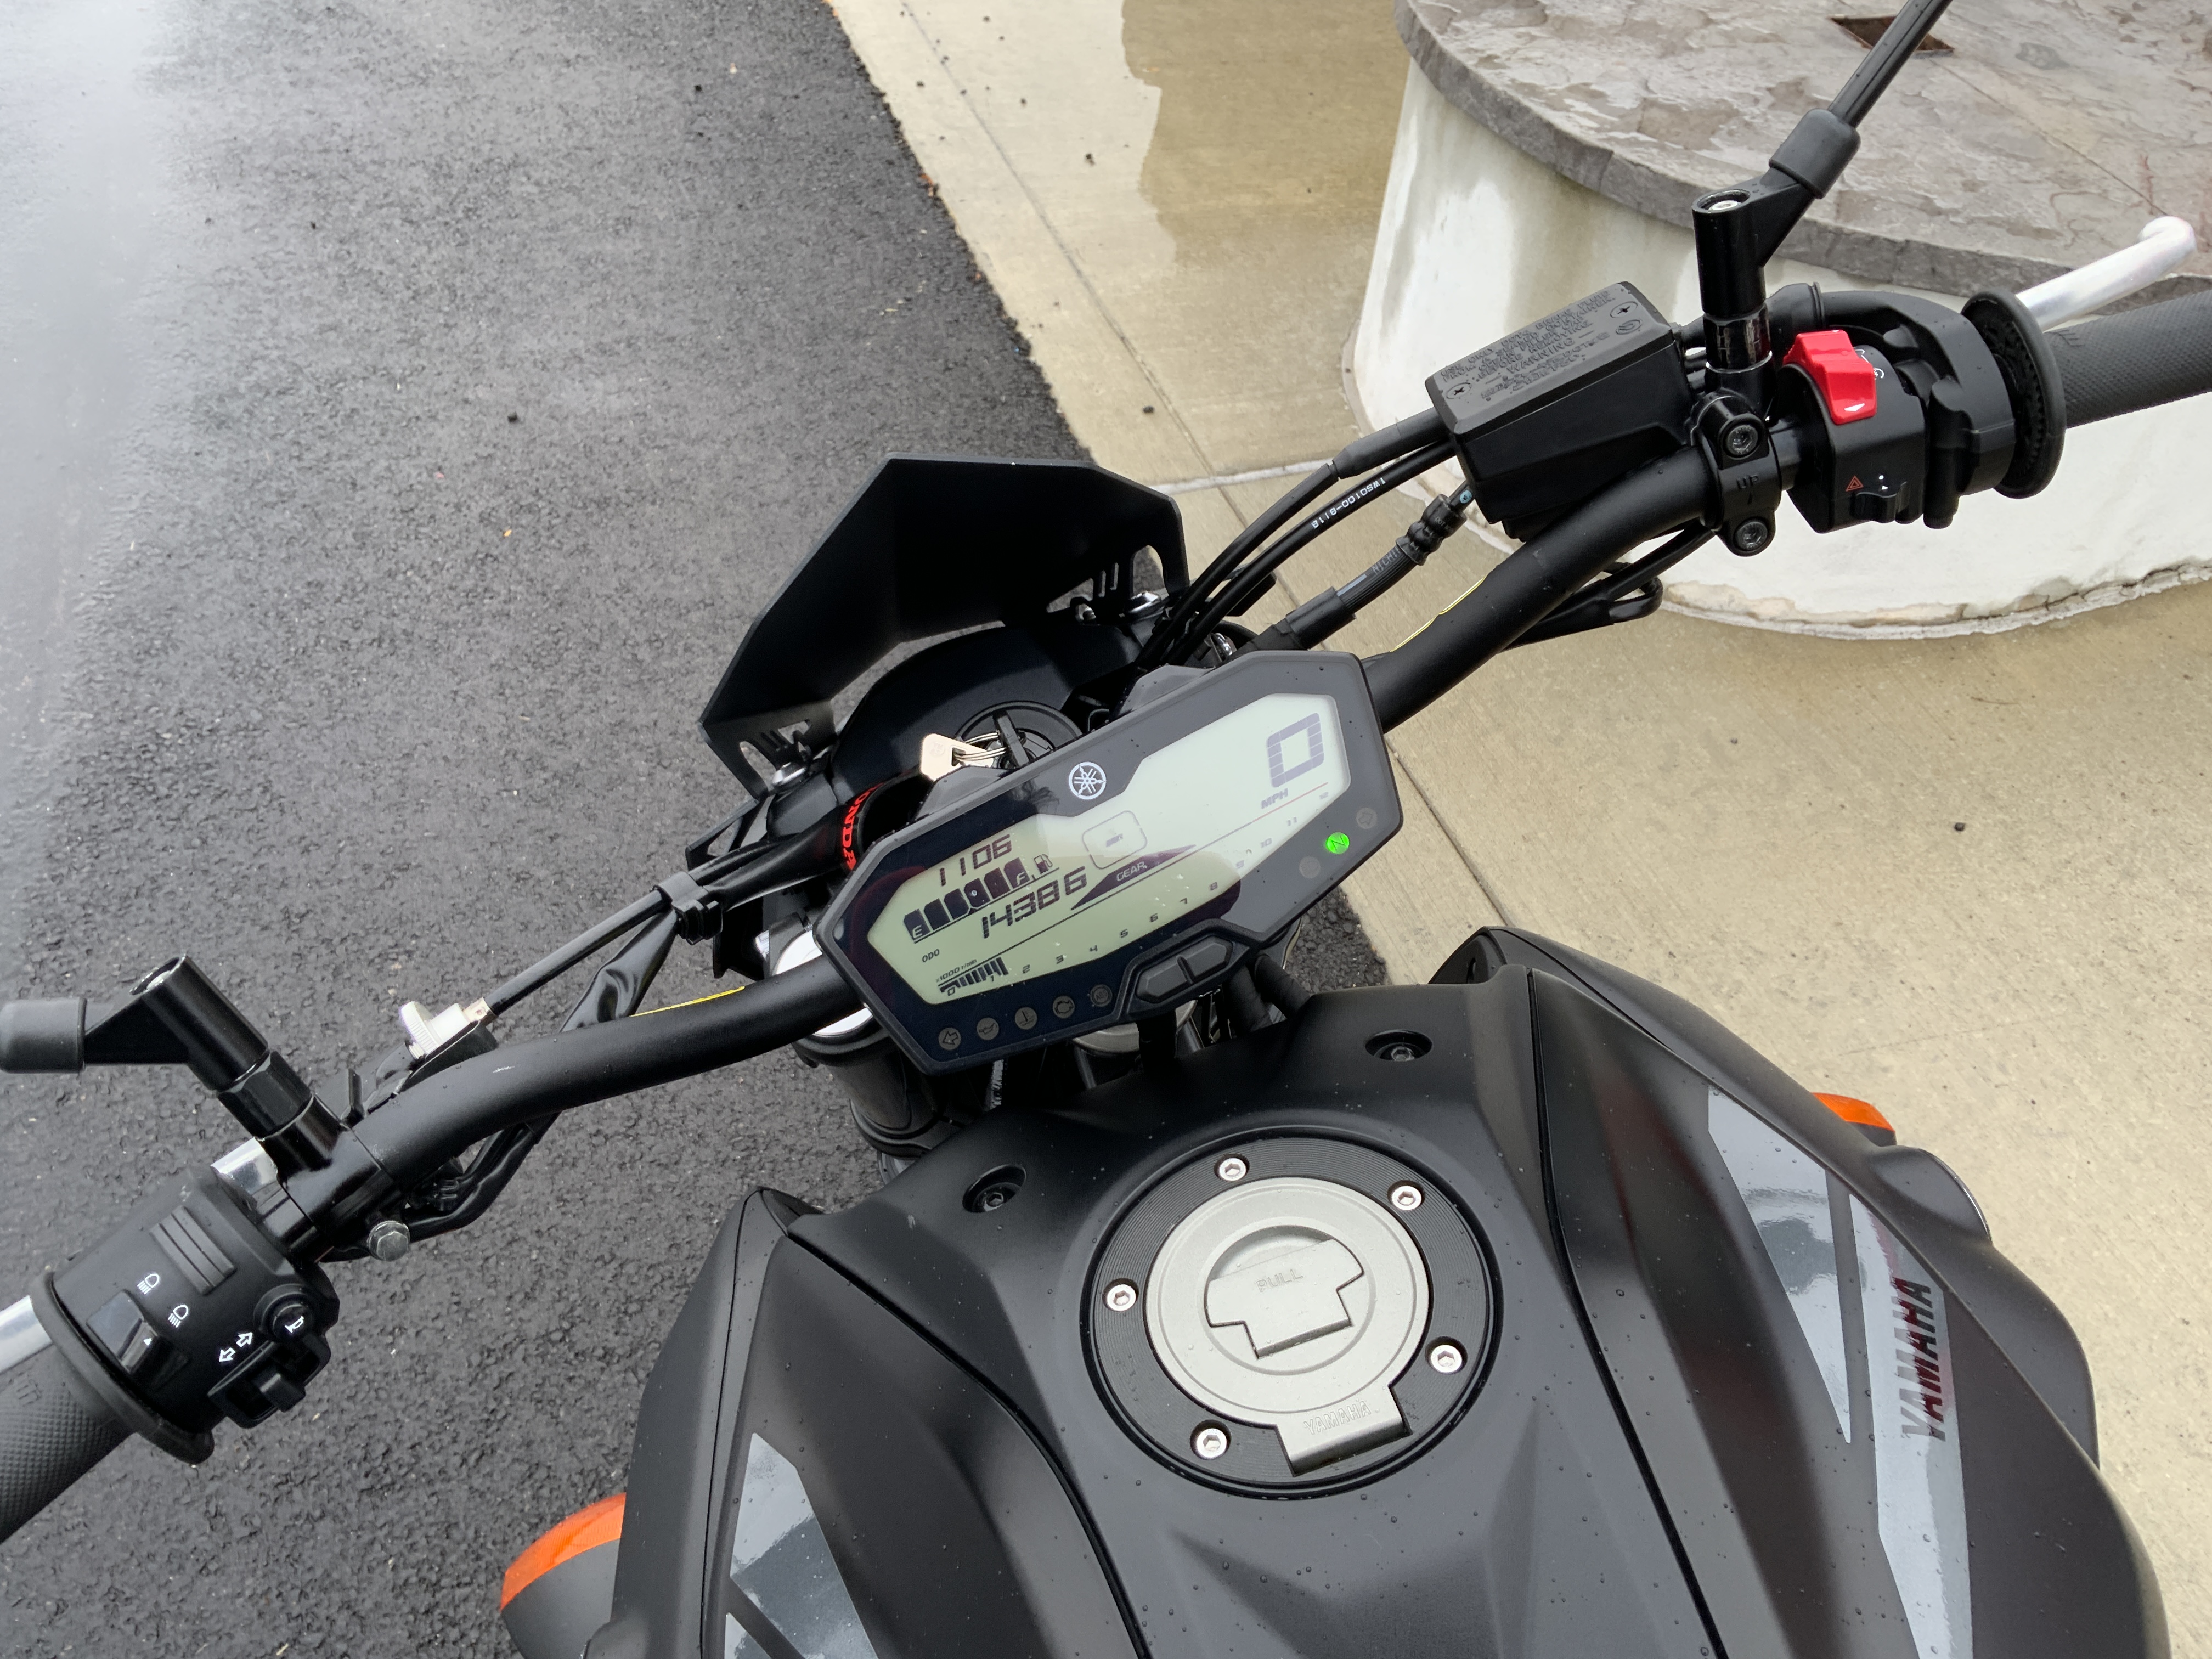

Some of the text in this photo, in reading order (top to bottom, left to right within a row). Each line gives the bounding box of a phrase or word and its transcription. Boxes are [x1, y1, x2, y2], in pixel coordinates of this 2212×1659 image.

[1736, 474, 1759, 490] UP
[1266, 713, 1325, 788] 0
[1261, 788, 1289, 809] MPH
[1331, 834, 1346, 852] N
[1016, 871, 1027, 886] F
[1116, 861, 1147, 882] GEAR
[947, 987, 956, 996] 0
[1022, 964, 1031, 974] 2
[1055, 955, 1064, 964] 3
[1089, 944, 1098, 952] 4
[1119, 928, 1128, 939] 5
[1149, 913, 1159, 923] 6
[1210, 882, 1218, 891] 8
[1235, 860, 1245, 870] 9
[1260, 837, 1273, 849] 10
[1286, 816, 1297, 827] 11
[1318, 791, 1329, 800] 12
[981, 866, 1087, 939] 14386
[912, 924, 923, 938] E
[922, 949, 940, 963] ODO
[961, 958, 978, 971] r/min
[1256, 1269, 1304, 1293] PULL
[1890, 1276, 1946, 1442] YAMAHA
[1304, 1400, 1372, 1435] YAMAHA
